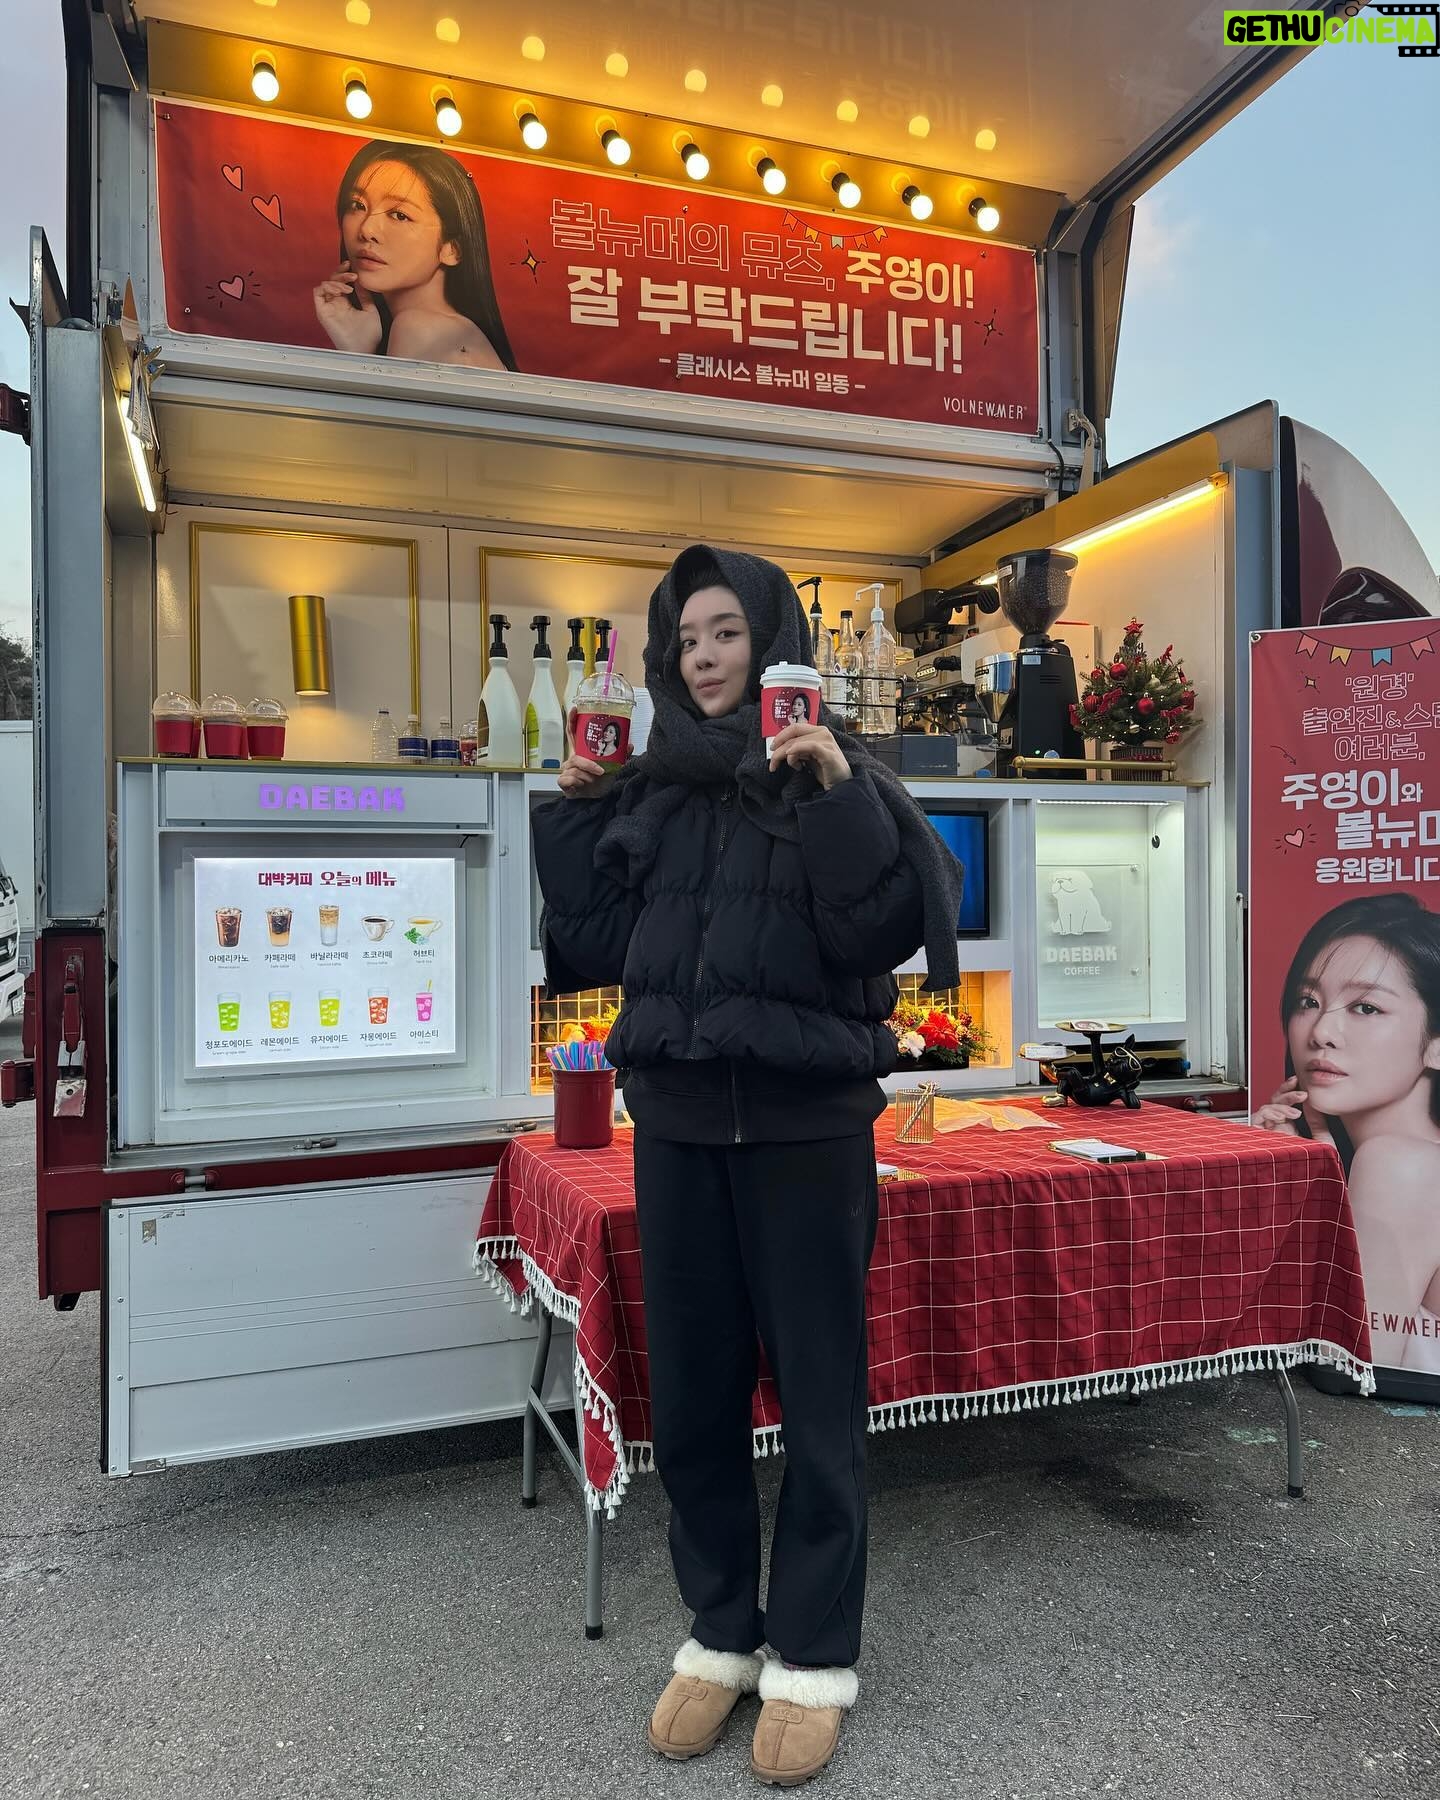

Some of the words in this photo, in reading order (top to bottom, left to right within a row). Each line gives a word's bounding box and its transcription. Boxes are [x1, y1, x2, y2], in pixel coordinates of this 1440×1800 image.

[550, 198, 730, 272] 볼뉴머의
[741, 231, 836, 291] 뮤즈,
[845, 250, 975, 308] 주영이!
[567, 265, 623, 327] 잘
[638, 276, 963, 374] 부탁드립니다!
[676, 352, 751, 382] 클래시스
[755, 363, 810, 391] 볼뉴머
[815, 371, 850, 395] 일동
[1334, 732, 1426, 762] 여러분,
[1281, 768, 1423, 810] 주영이와
[259, 783, 405, 813] DAEBAK
[258, 872, 313, 886] 대박커피
[320, 871, 362, 887] 오늘의
[365, 871, 397, 887] 메뉴
[208, 953, 249, 964] 아메리카노
[413, 949, 435, 959] 허브티
[1045, 946, 1118, 963] DAEBAK
[1064, 966, 1101, 976] COFFEE
[310, 1034, 349, 1045] 유자에이드
[359, 1031, 397, 1042] 자몽에이드
[409, 1029, 439, 1039] 아이스티
[205, 1038, 253, 1049] 청포도에이드
[260, 1036, 300, 1046] 레몬에이드
